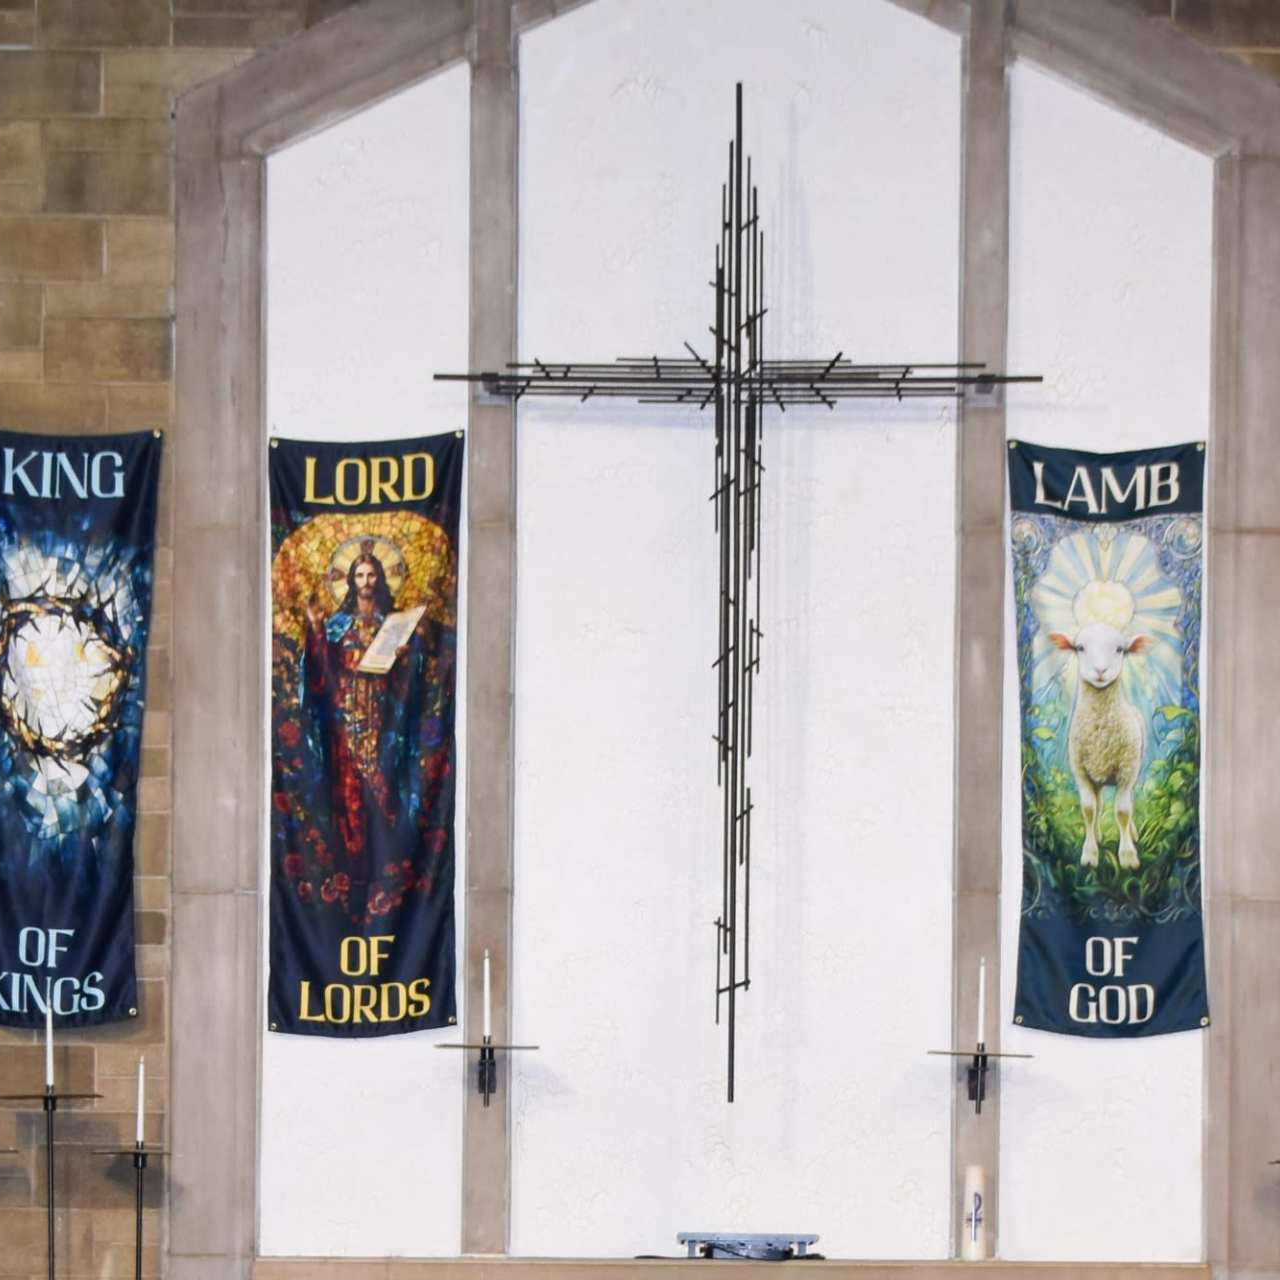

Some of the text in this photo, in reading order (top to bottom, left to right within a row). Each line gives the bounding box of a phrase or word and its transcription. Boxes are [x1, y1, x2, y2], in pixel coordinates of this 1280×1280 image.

[3, 448, 125, 499] KING
[304, 453, 434, 505] LORD
[1032, 461, 1180, 514] LAMB
[19, 926, 75, 968] OF
[340, 935, 396, 976] OF
[1085, 936, 1139, 977] OF
[299, 978, 430, 1024] LORDS
[1069, 983, 1155, 1025] GOD
